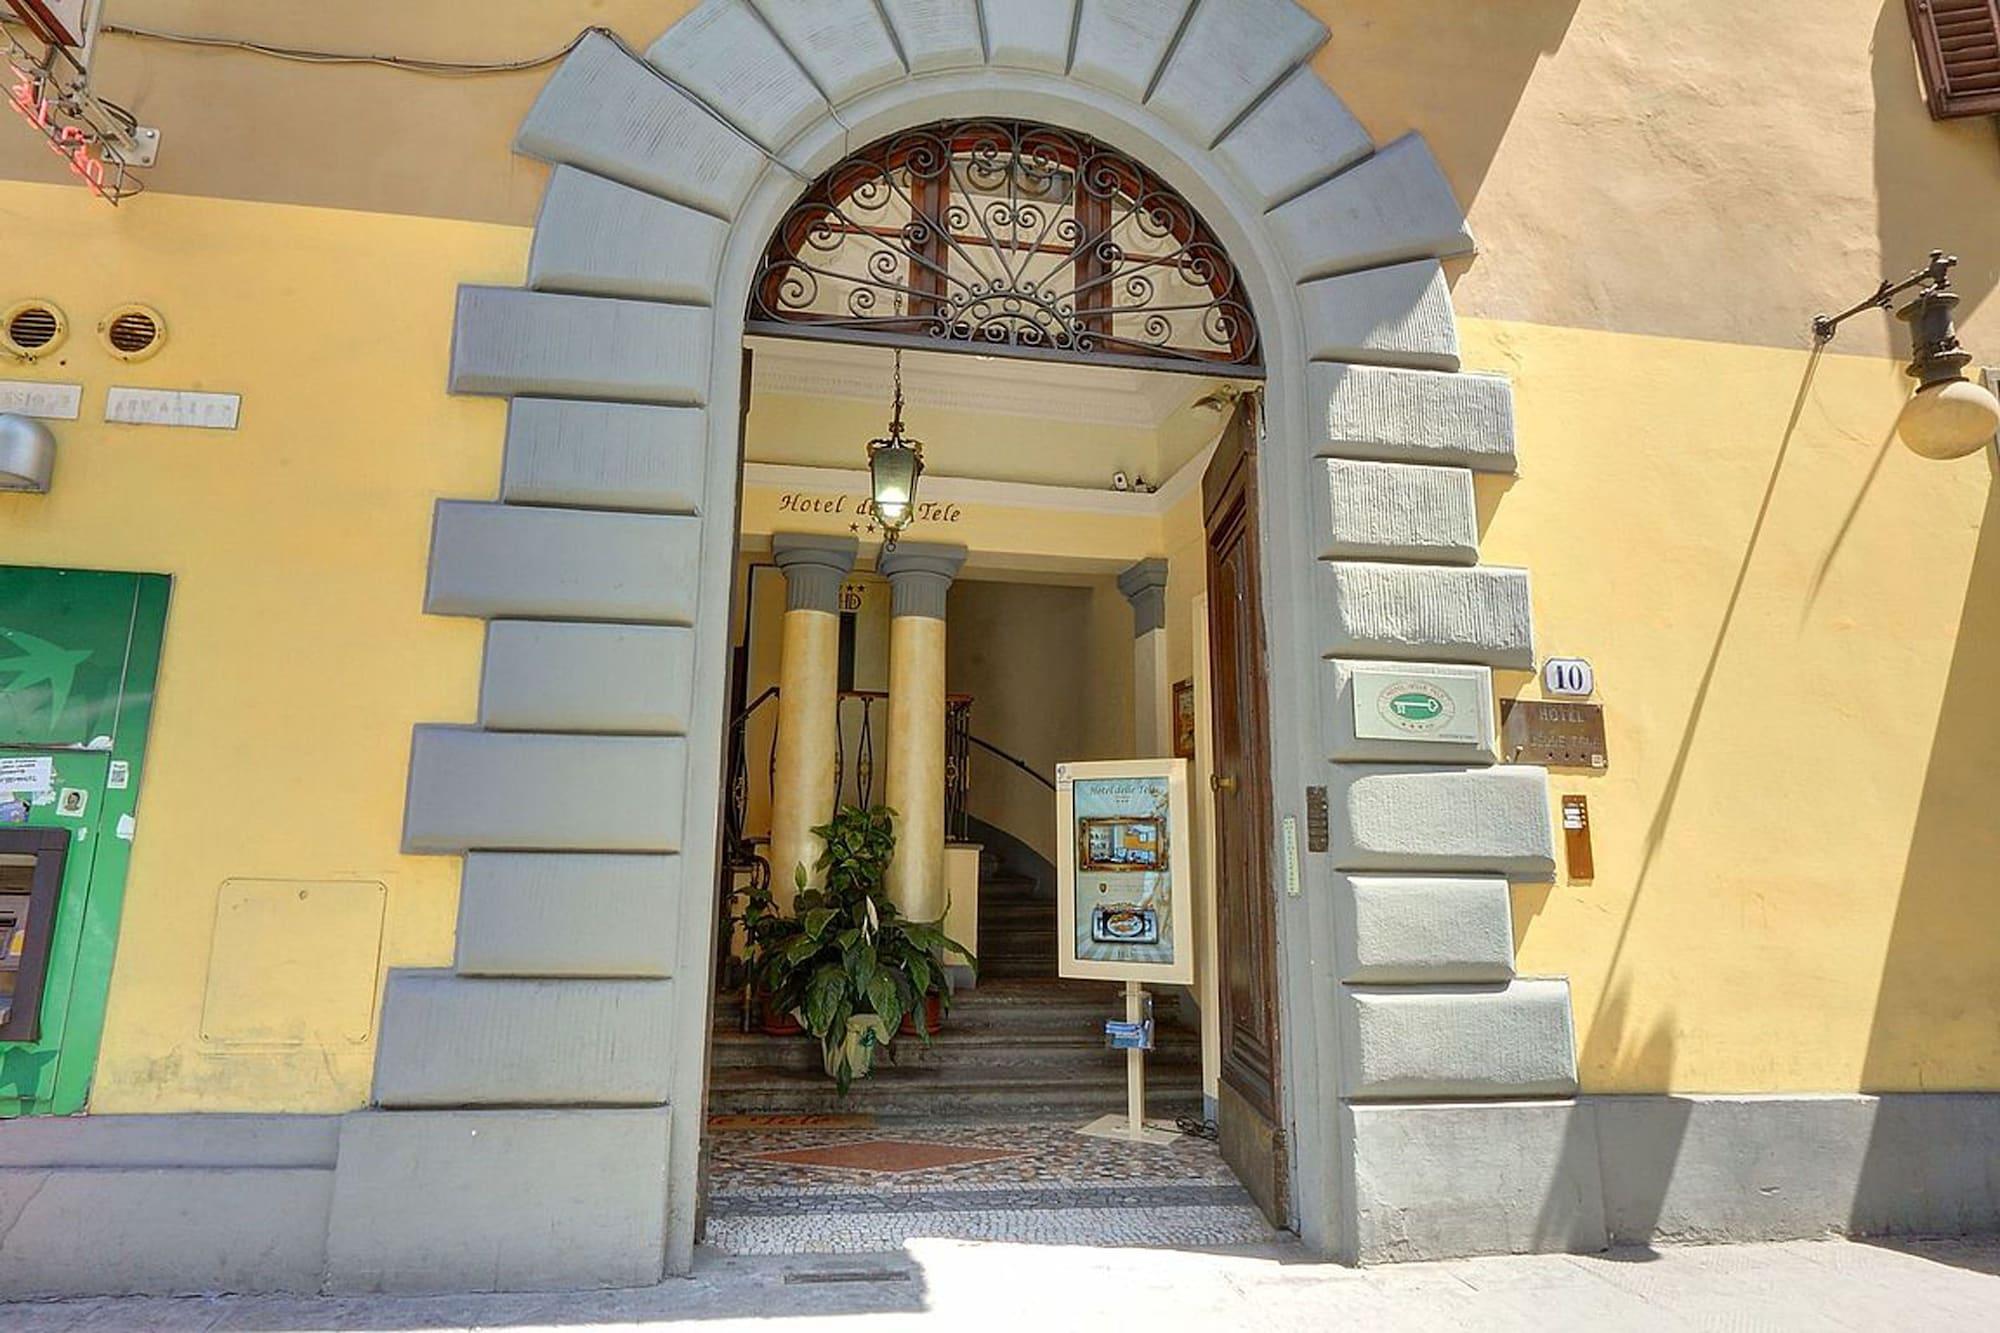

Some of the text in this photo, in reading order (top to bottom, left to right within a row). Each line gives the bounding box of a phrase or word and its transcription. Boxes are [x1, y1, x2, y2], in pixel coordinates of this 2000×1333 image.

[779, 493, 847, 513] Hotel
[918, 502, 961, 522] Tele
[1555, 665, 1583, 691] 10
